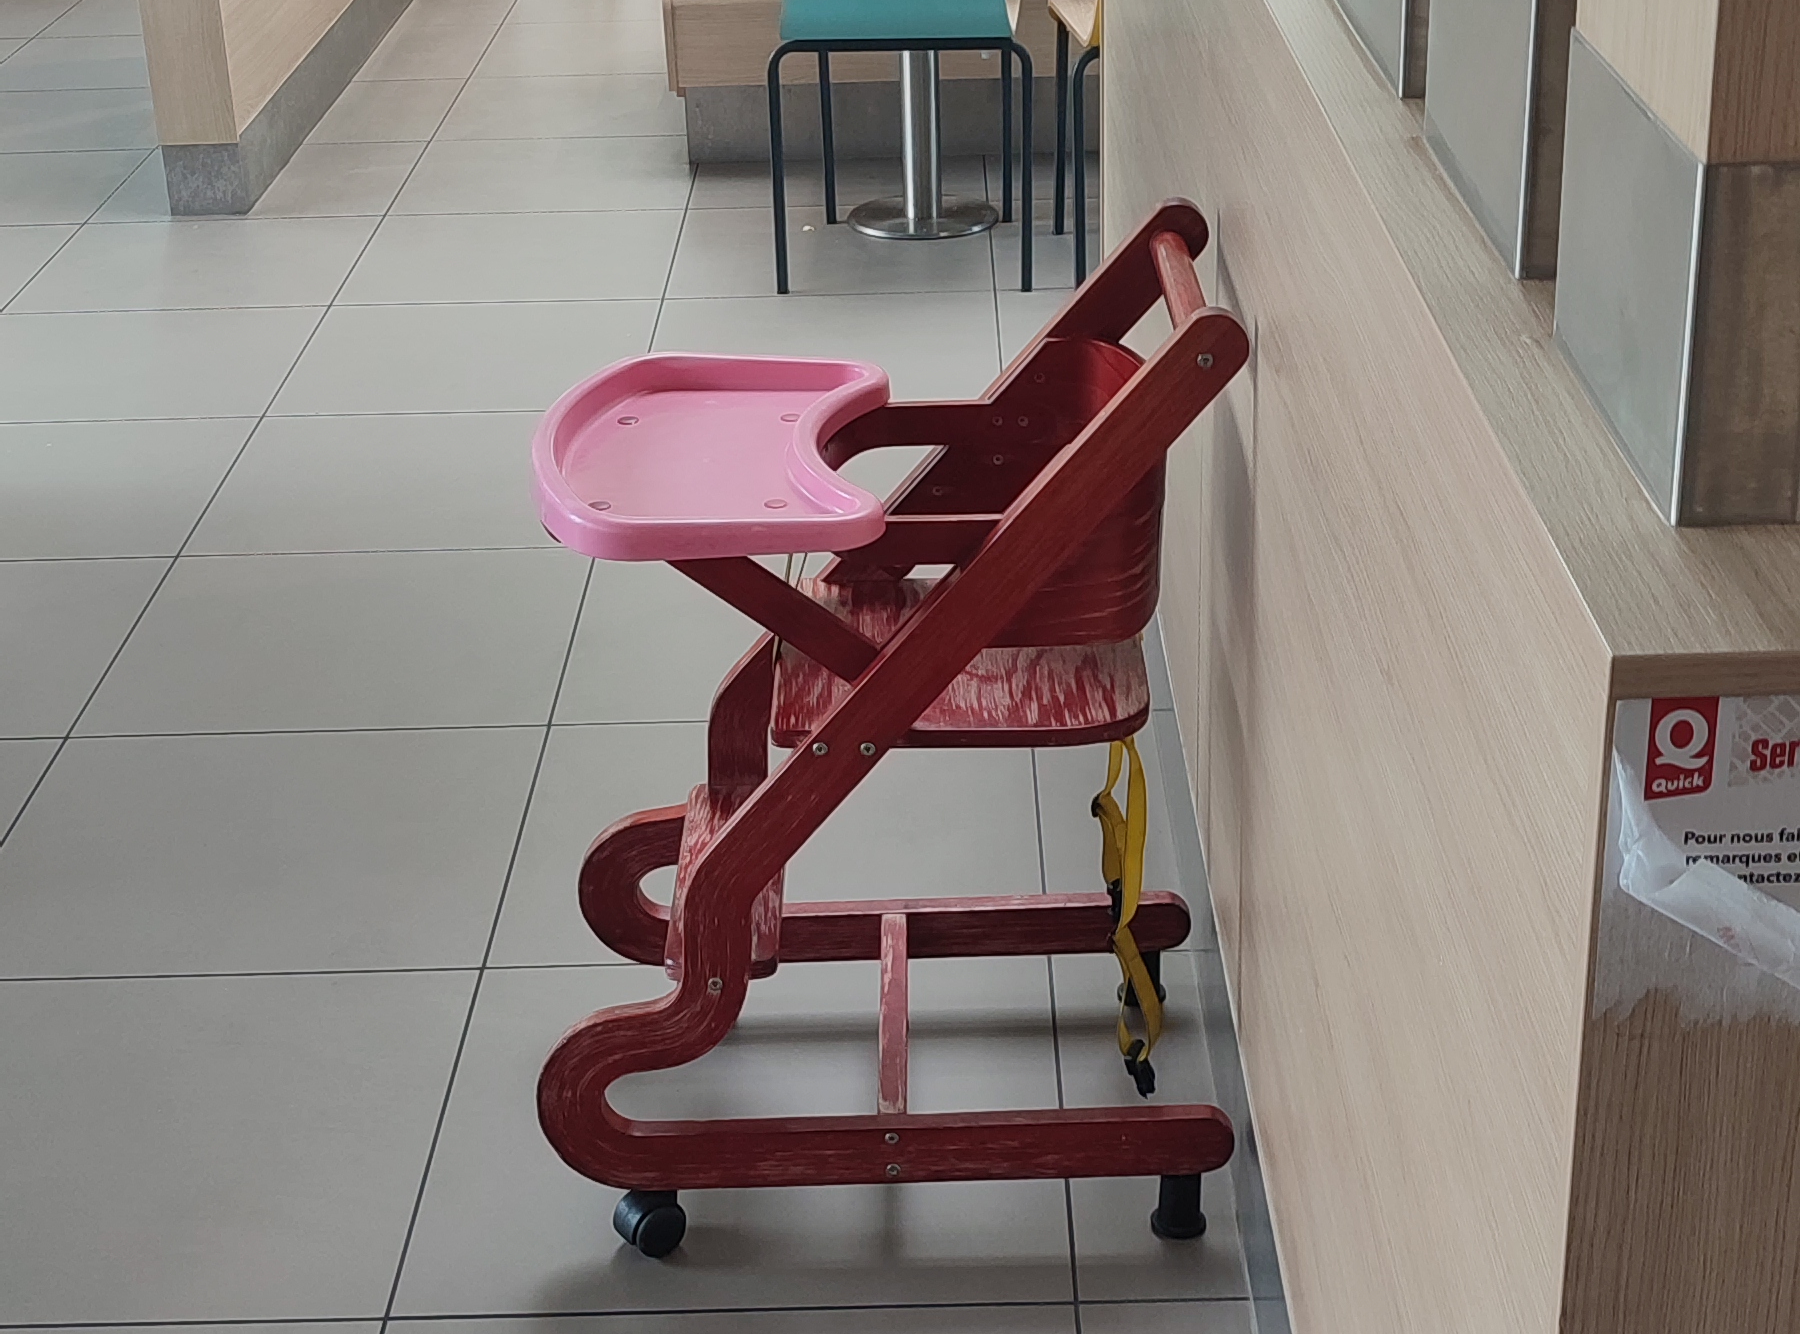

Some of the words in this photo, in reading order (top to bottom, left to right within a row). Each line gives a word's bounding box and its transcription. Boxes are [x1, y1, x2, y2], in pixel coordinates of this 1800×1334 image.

[1654, 708, 1709, 769] Q
[1749, 737, 1800, 772] Ser
[1652, 772, 1705, 793] Quick
[1684, 831, 1726, 845] Pour
[1730, 832, 1774, 844] nous
